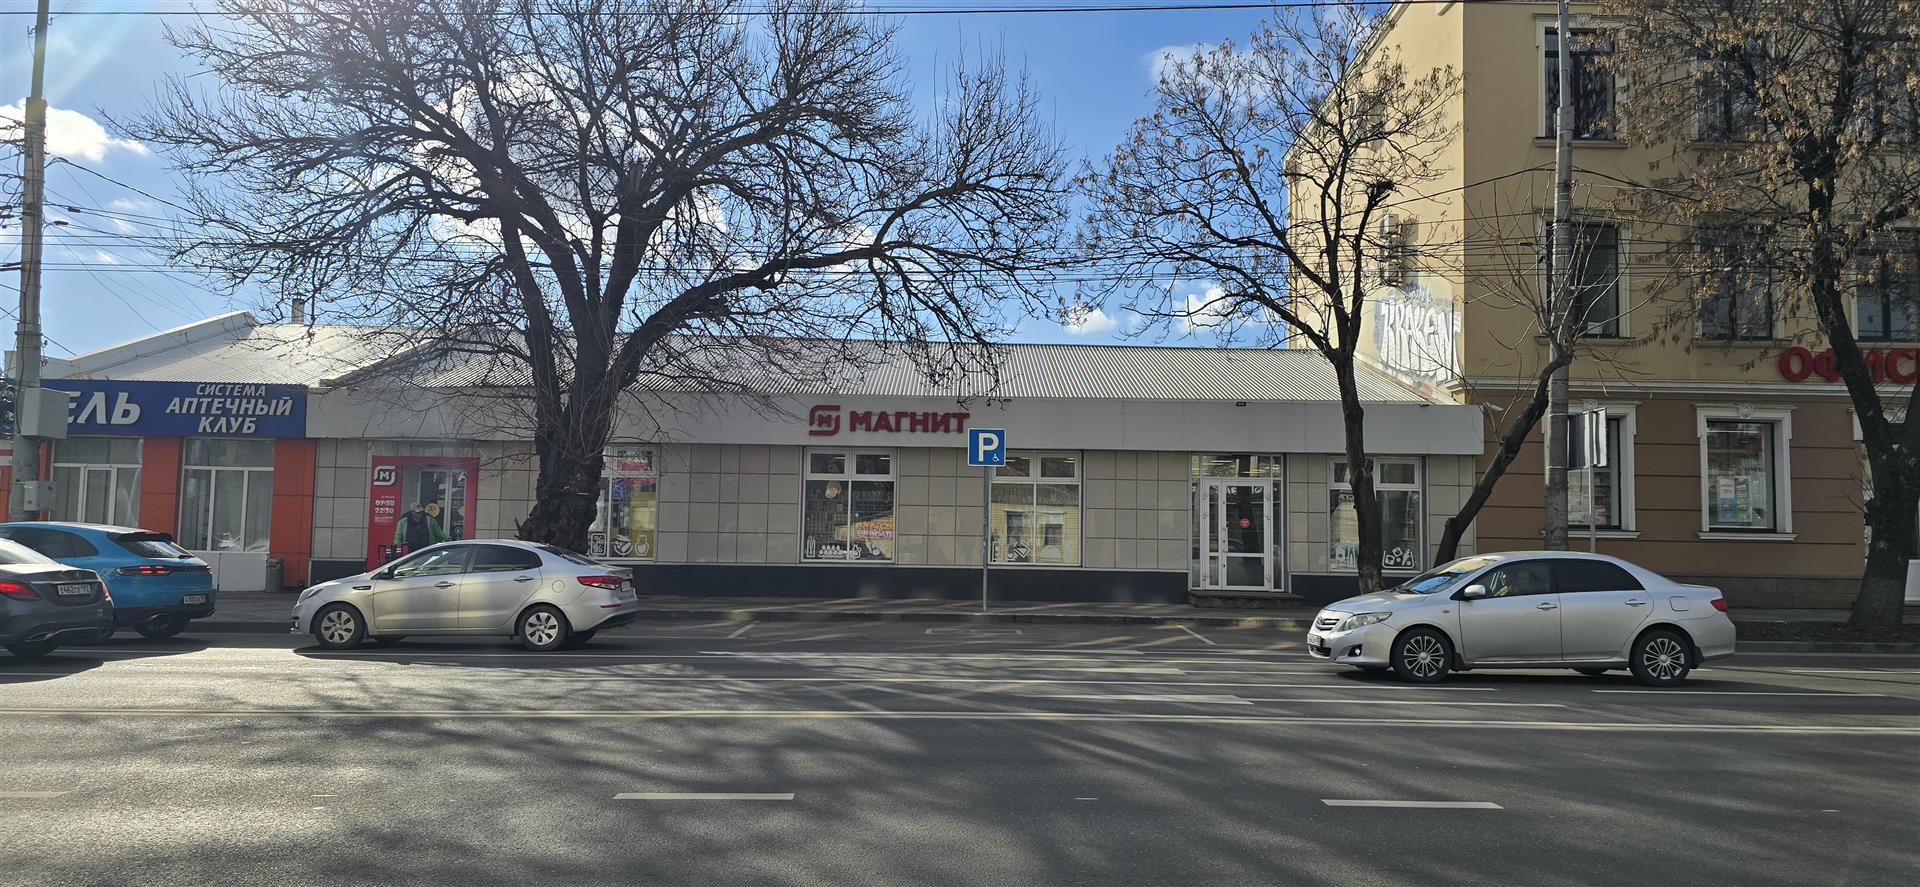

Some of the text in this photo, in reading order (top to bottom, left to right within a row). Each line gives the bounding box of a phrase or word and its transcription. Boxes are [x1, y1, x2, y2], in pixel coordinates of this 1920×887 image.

[196, 384, 266, 397] СИСТЕМА
[165, 396, 294, 416] АПТЕЧНЫЙ
[198, 417, 256, 433] КЛУБ
[849, 410, 971, 434] МАГНИТ
[978, 432, 999, 462] P
